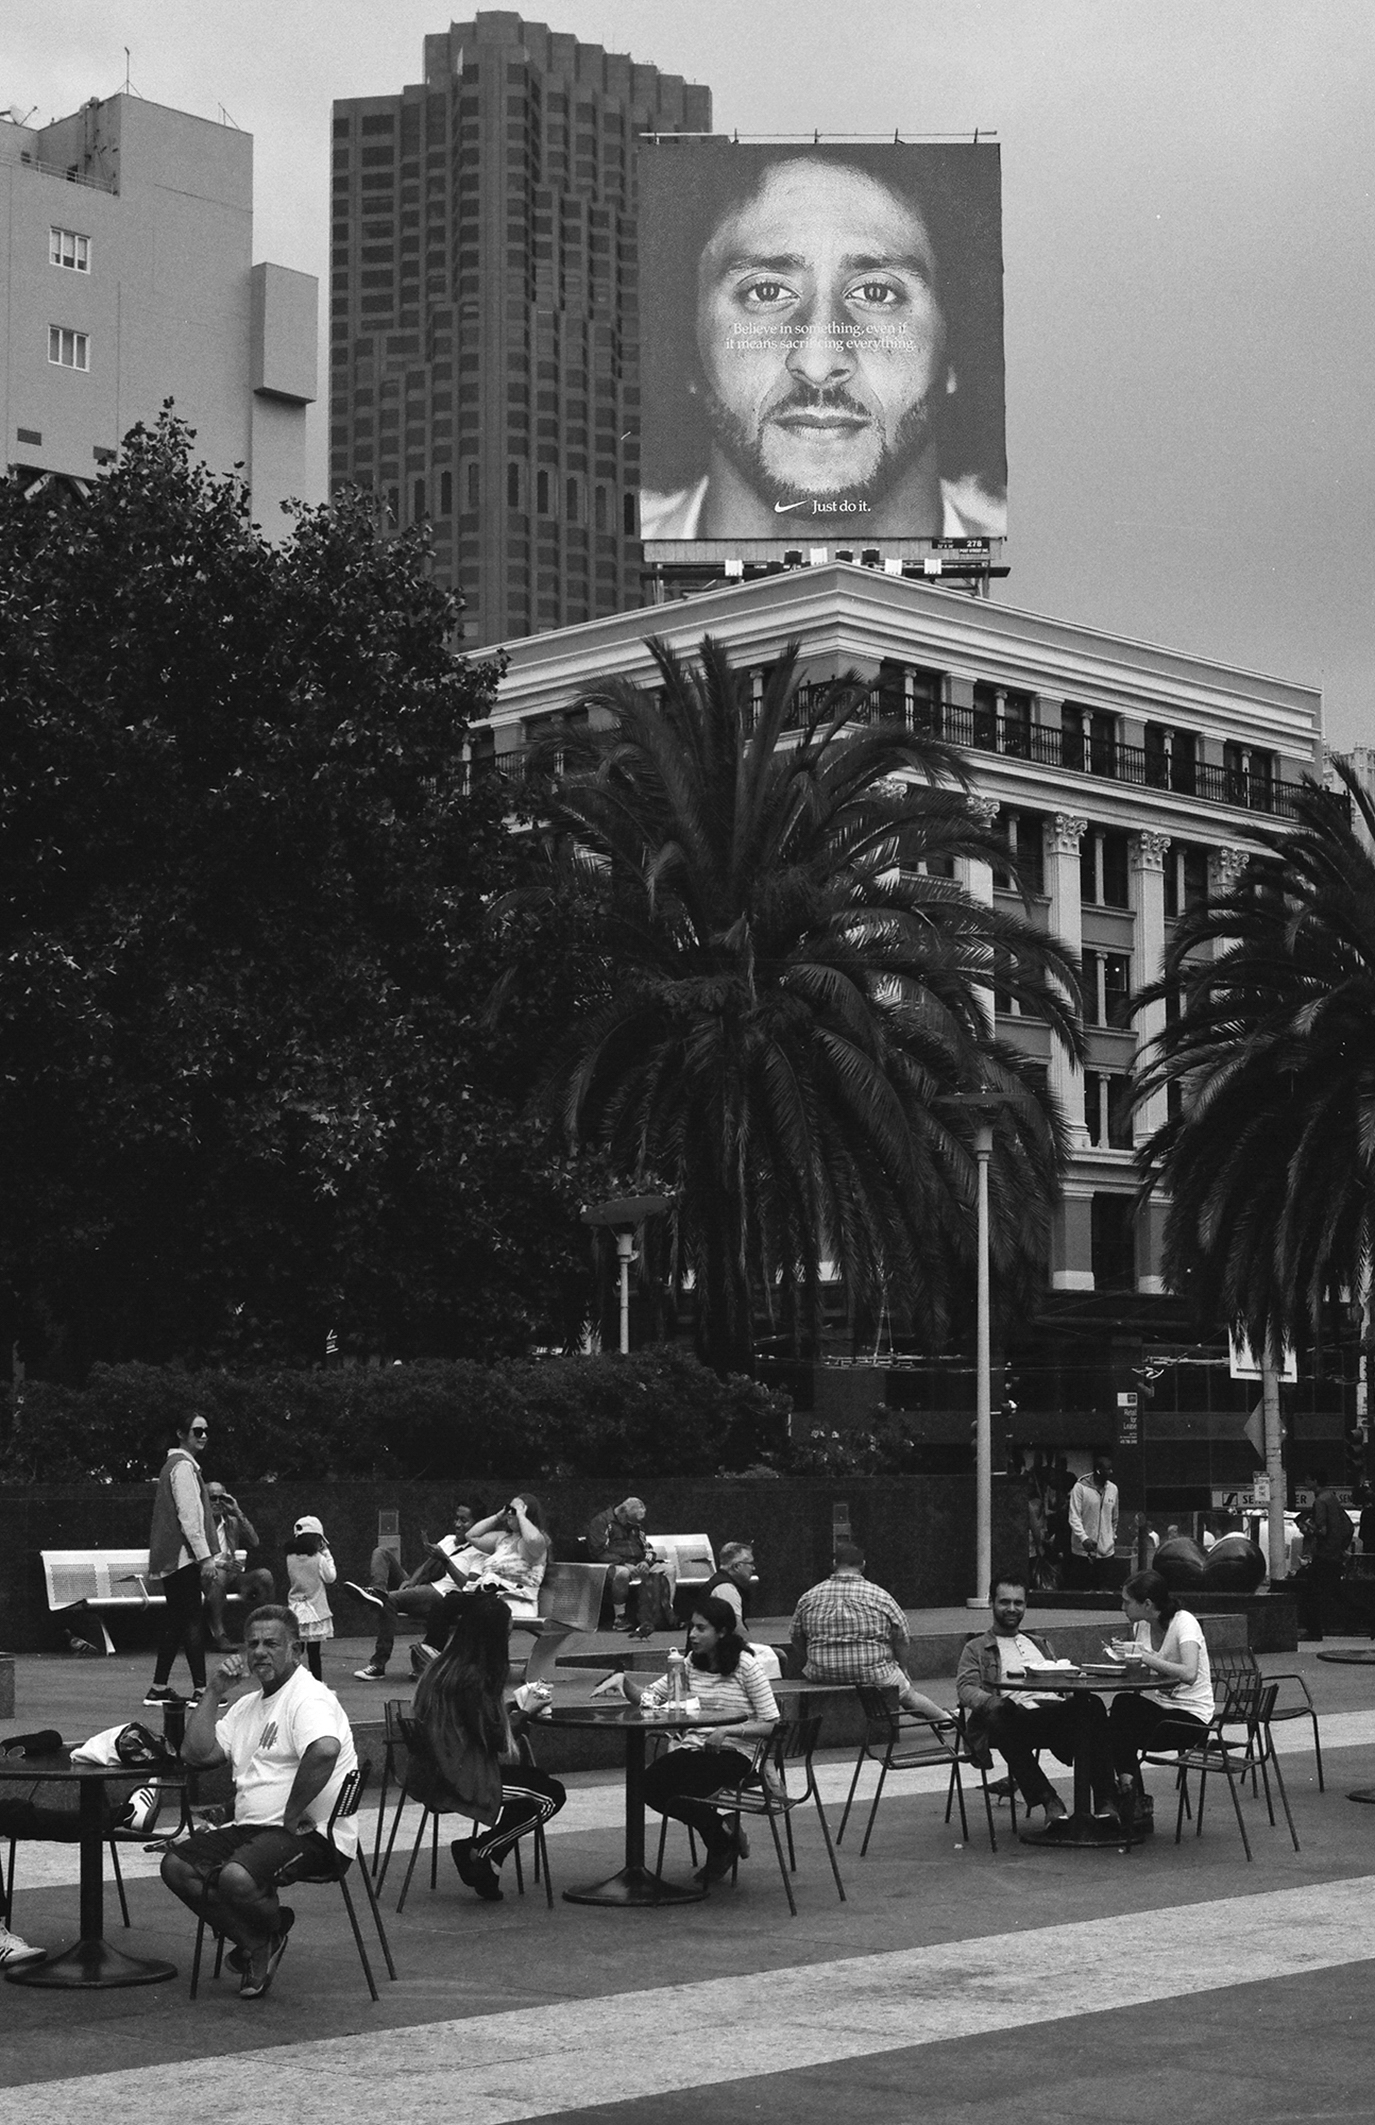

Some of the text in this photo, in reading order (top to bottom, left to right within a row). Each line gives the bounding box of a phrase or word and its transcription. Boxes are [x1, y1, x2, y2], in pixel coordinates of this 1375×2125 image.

[733, 321, 908, 337] Believe in something, even if
[726, 336, 918, 353] it means sacricing everything.
[812, 499, 872, 515] Just do it.
[966, 540, 982, 548] 278
